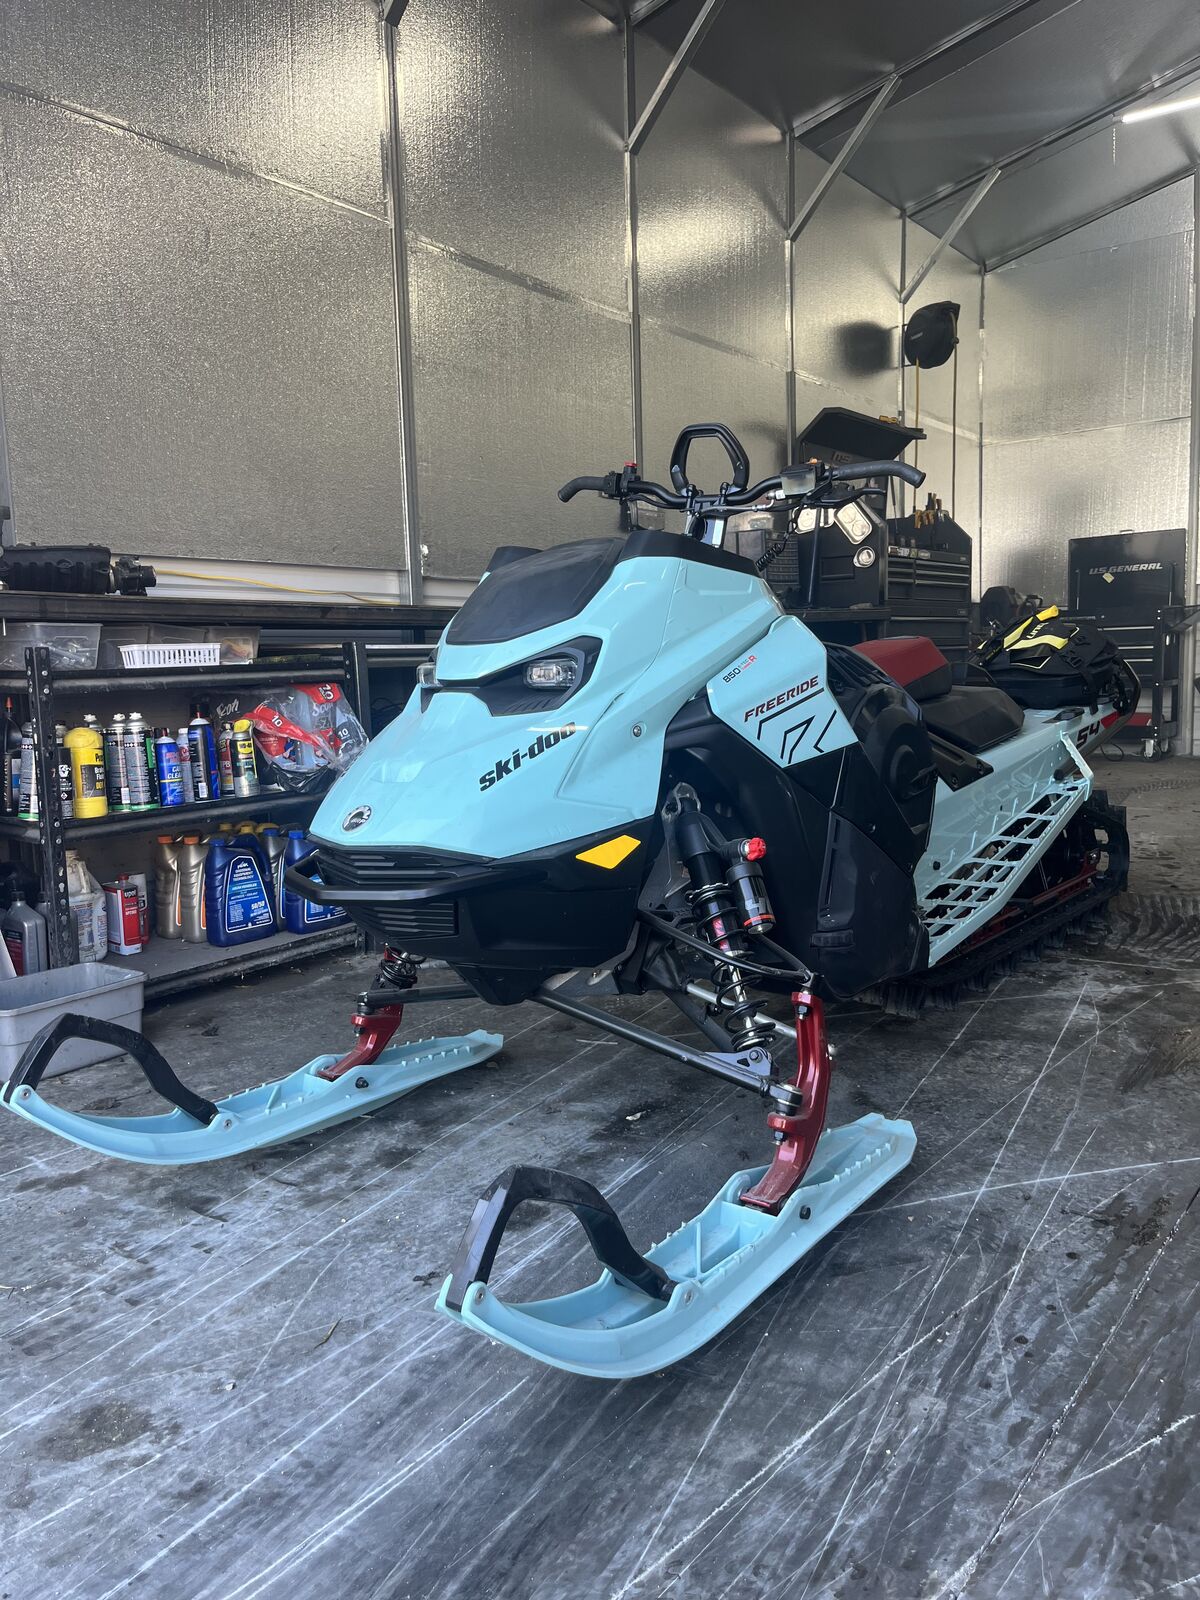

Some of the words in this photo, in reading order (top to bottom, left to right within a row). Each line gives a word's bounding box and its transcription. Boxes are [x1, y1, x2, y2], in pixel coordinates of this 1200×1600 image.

[1109, 562, 1163, 573] GENERAL
[722, 667, 742, 683] 850
[744, 675, 819, 723] FREERIDE
[271, 714, 283, 727] 10
[338, 728, 349, 738] 10
[479, 721, 576, 792] ski-doo
